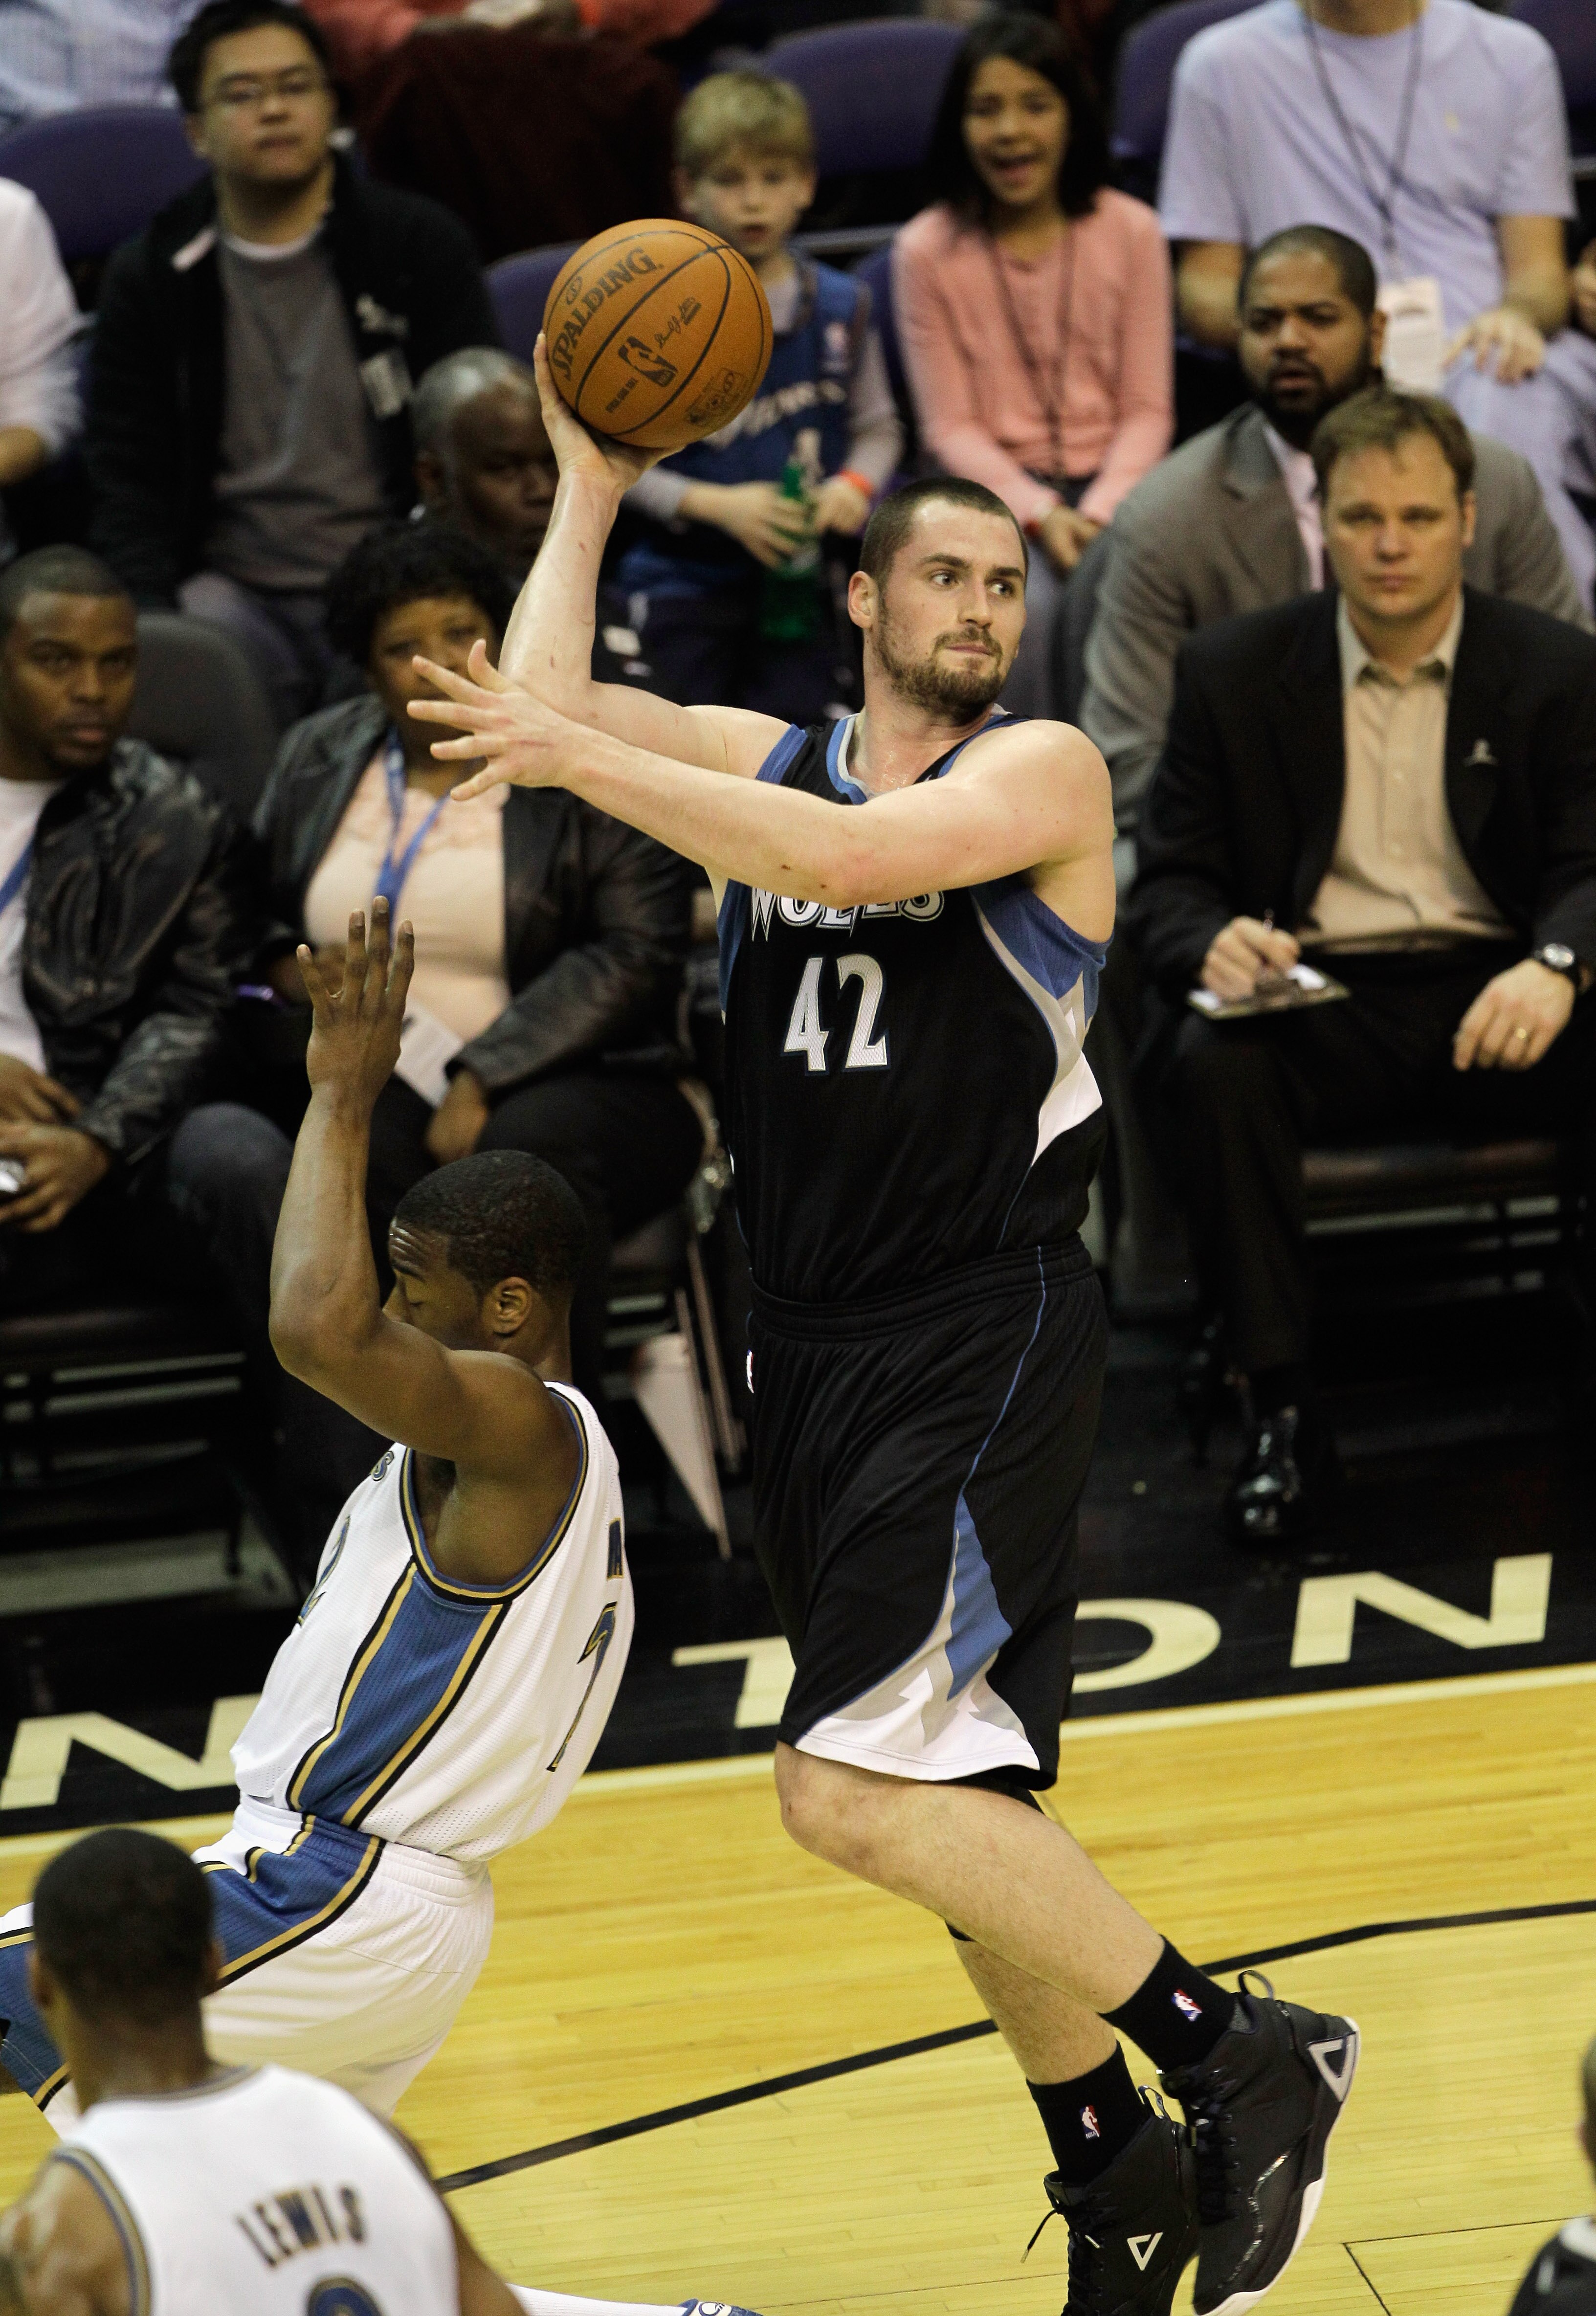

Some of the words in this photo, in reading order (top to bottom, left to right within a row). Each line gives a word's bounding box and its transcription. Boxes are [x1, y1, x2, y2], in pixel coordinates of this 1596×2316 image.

[552, 245, 658, 382] SPALDING
[783, 953, 888, 1072] 42
[235, 2183, 365, 2268] LEWIS
